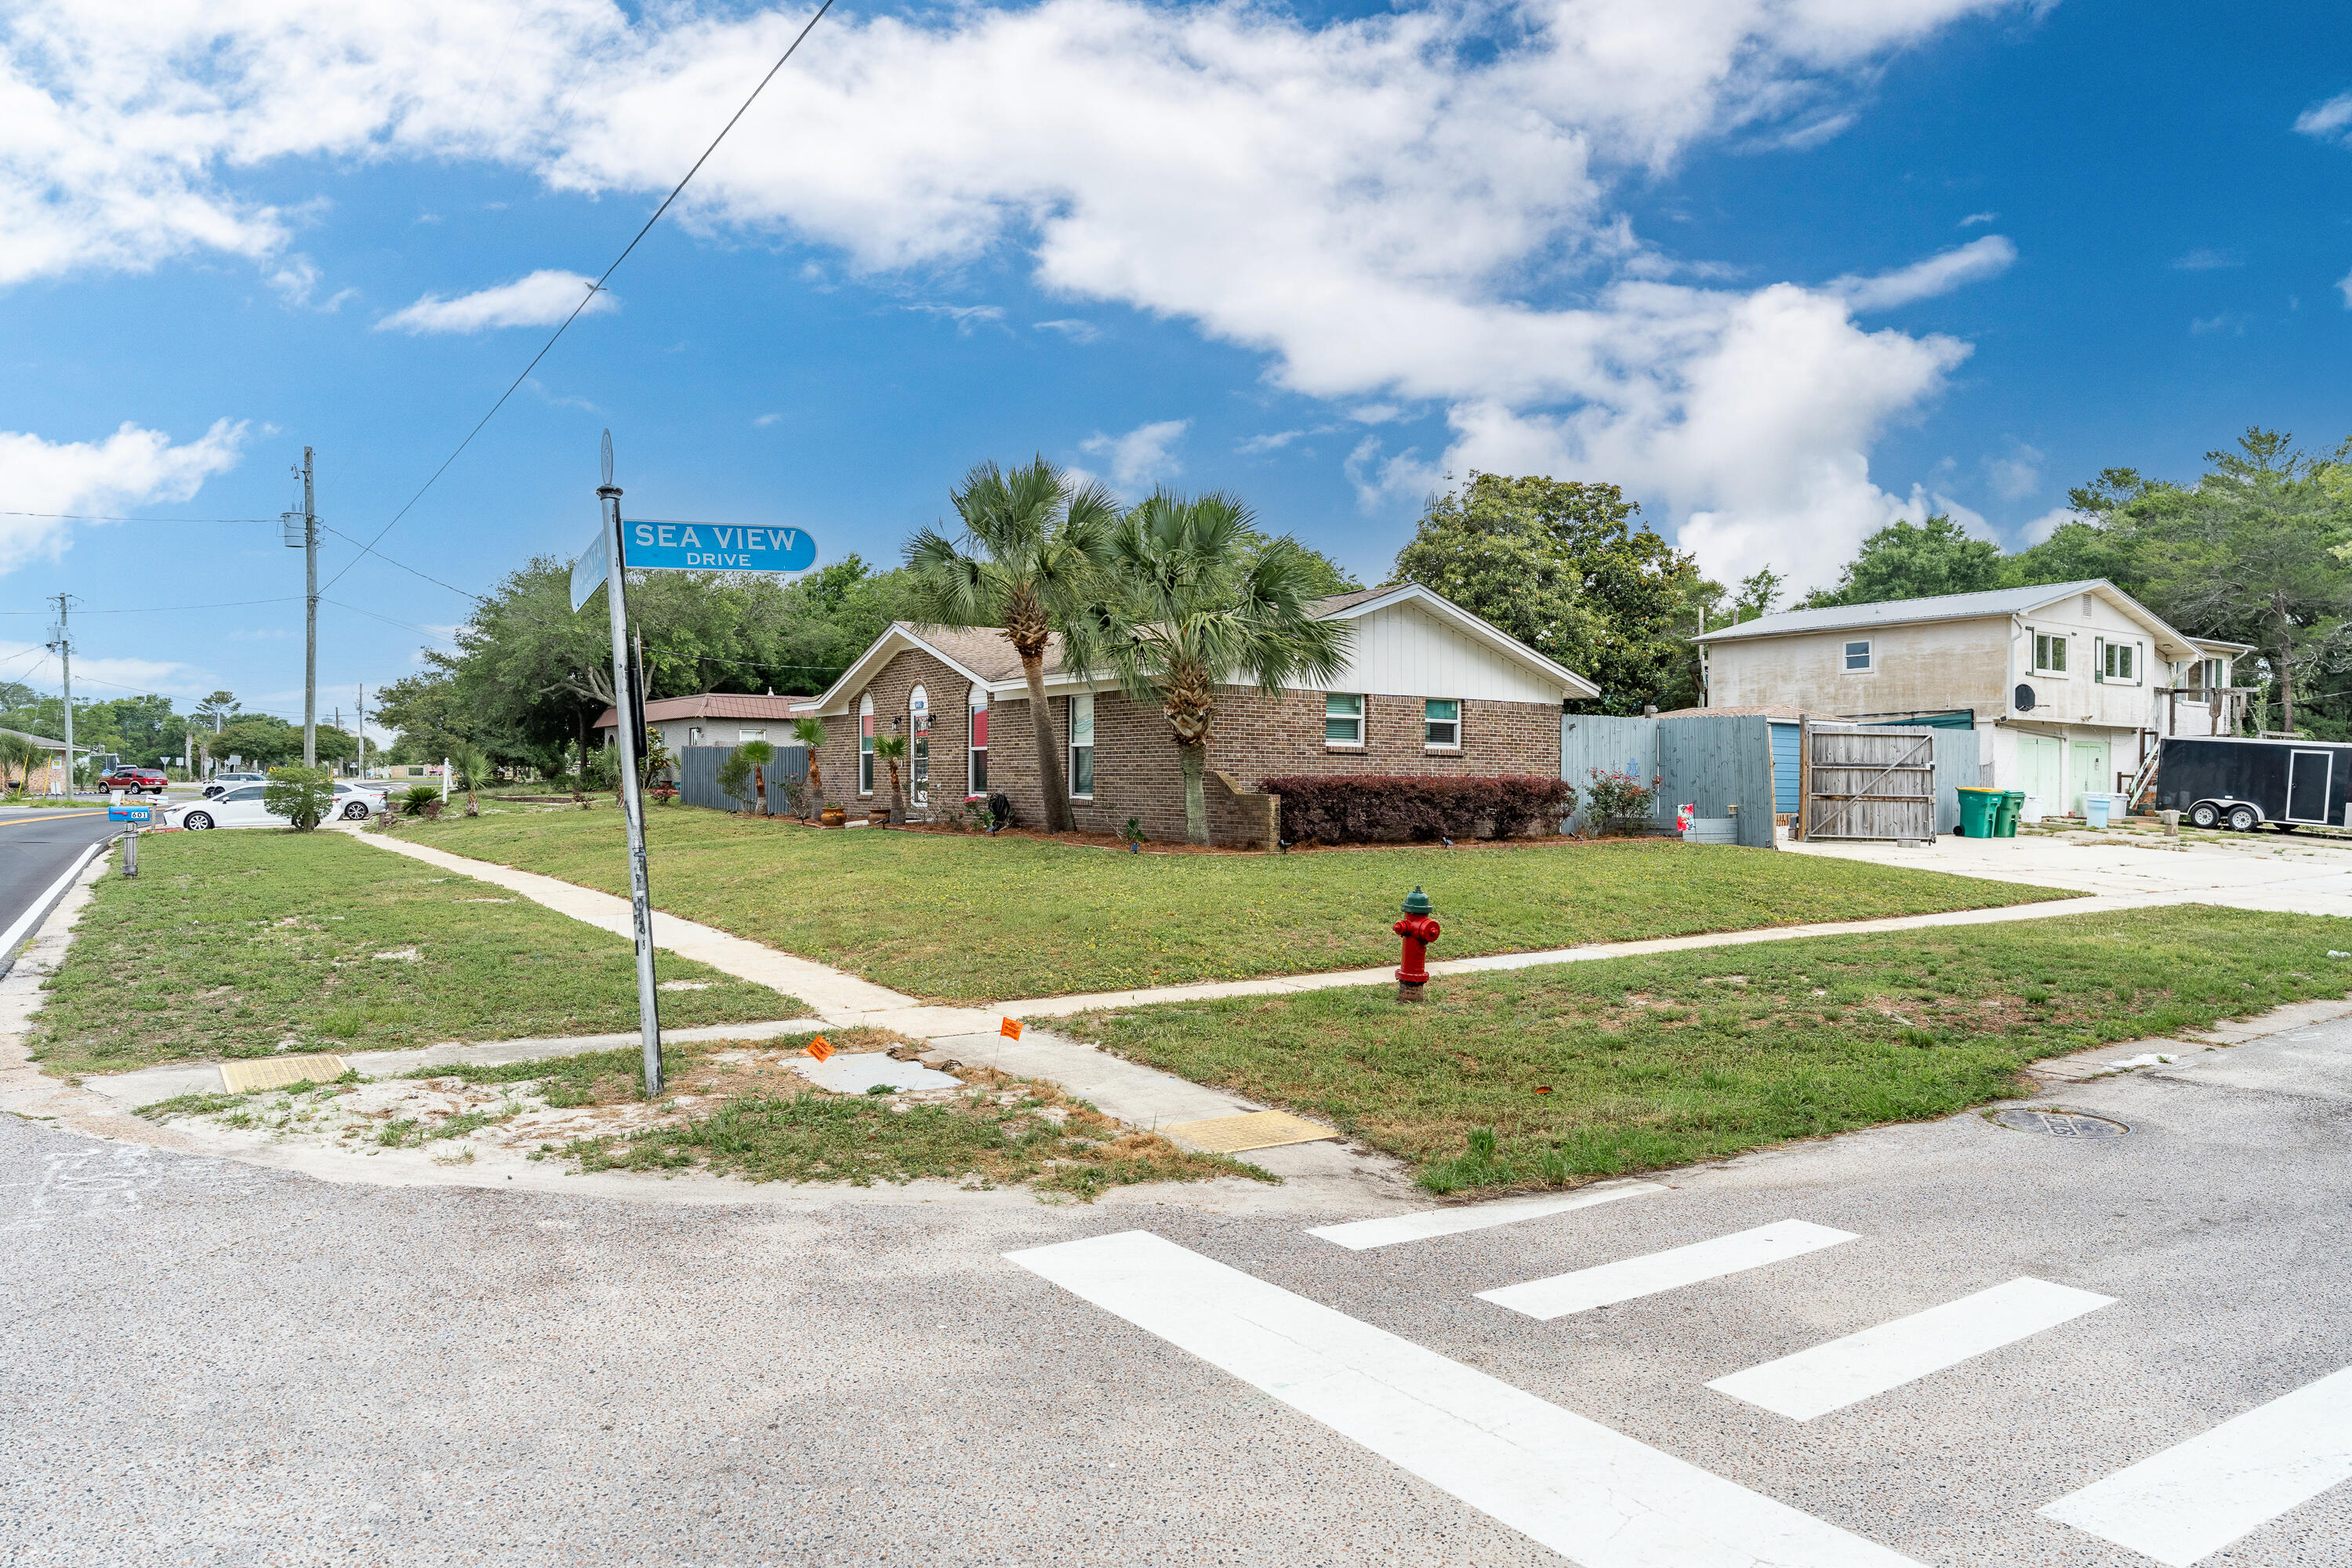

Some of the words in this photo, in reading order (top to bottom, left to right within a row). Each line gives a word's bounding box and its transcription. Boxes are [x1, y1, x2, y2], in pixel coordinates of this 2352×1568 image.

[635, 524, 702, 548] SEA
[712, 527, 797, 551] VIEW
[573, 535, 607, 591] MOUNTAI
[687, 552, 752, 567] DRIVE
[584, 571, 600, 597] DRIVE
